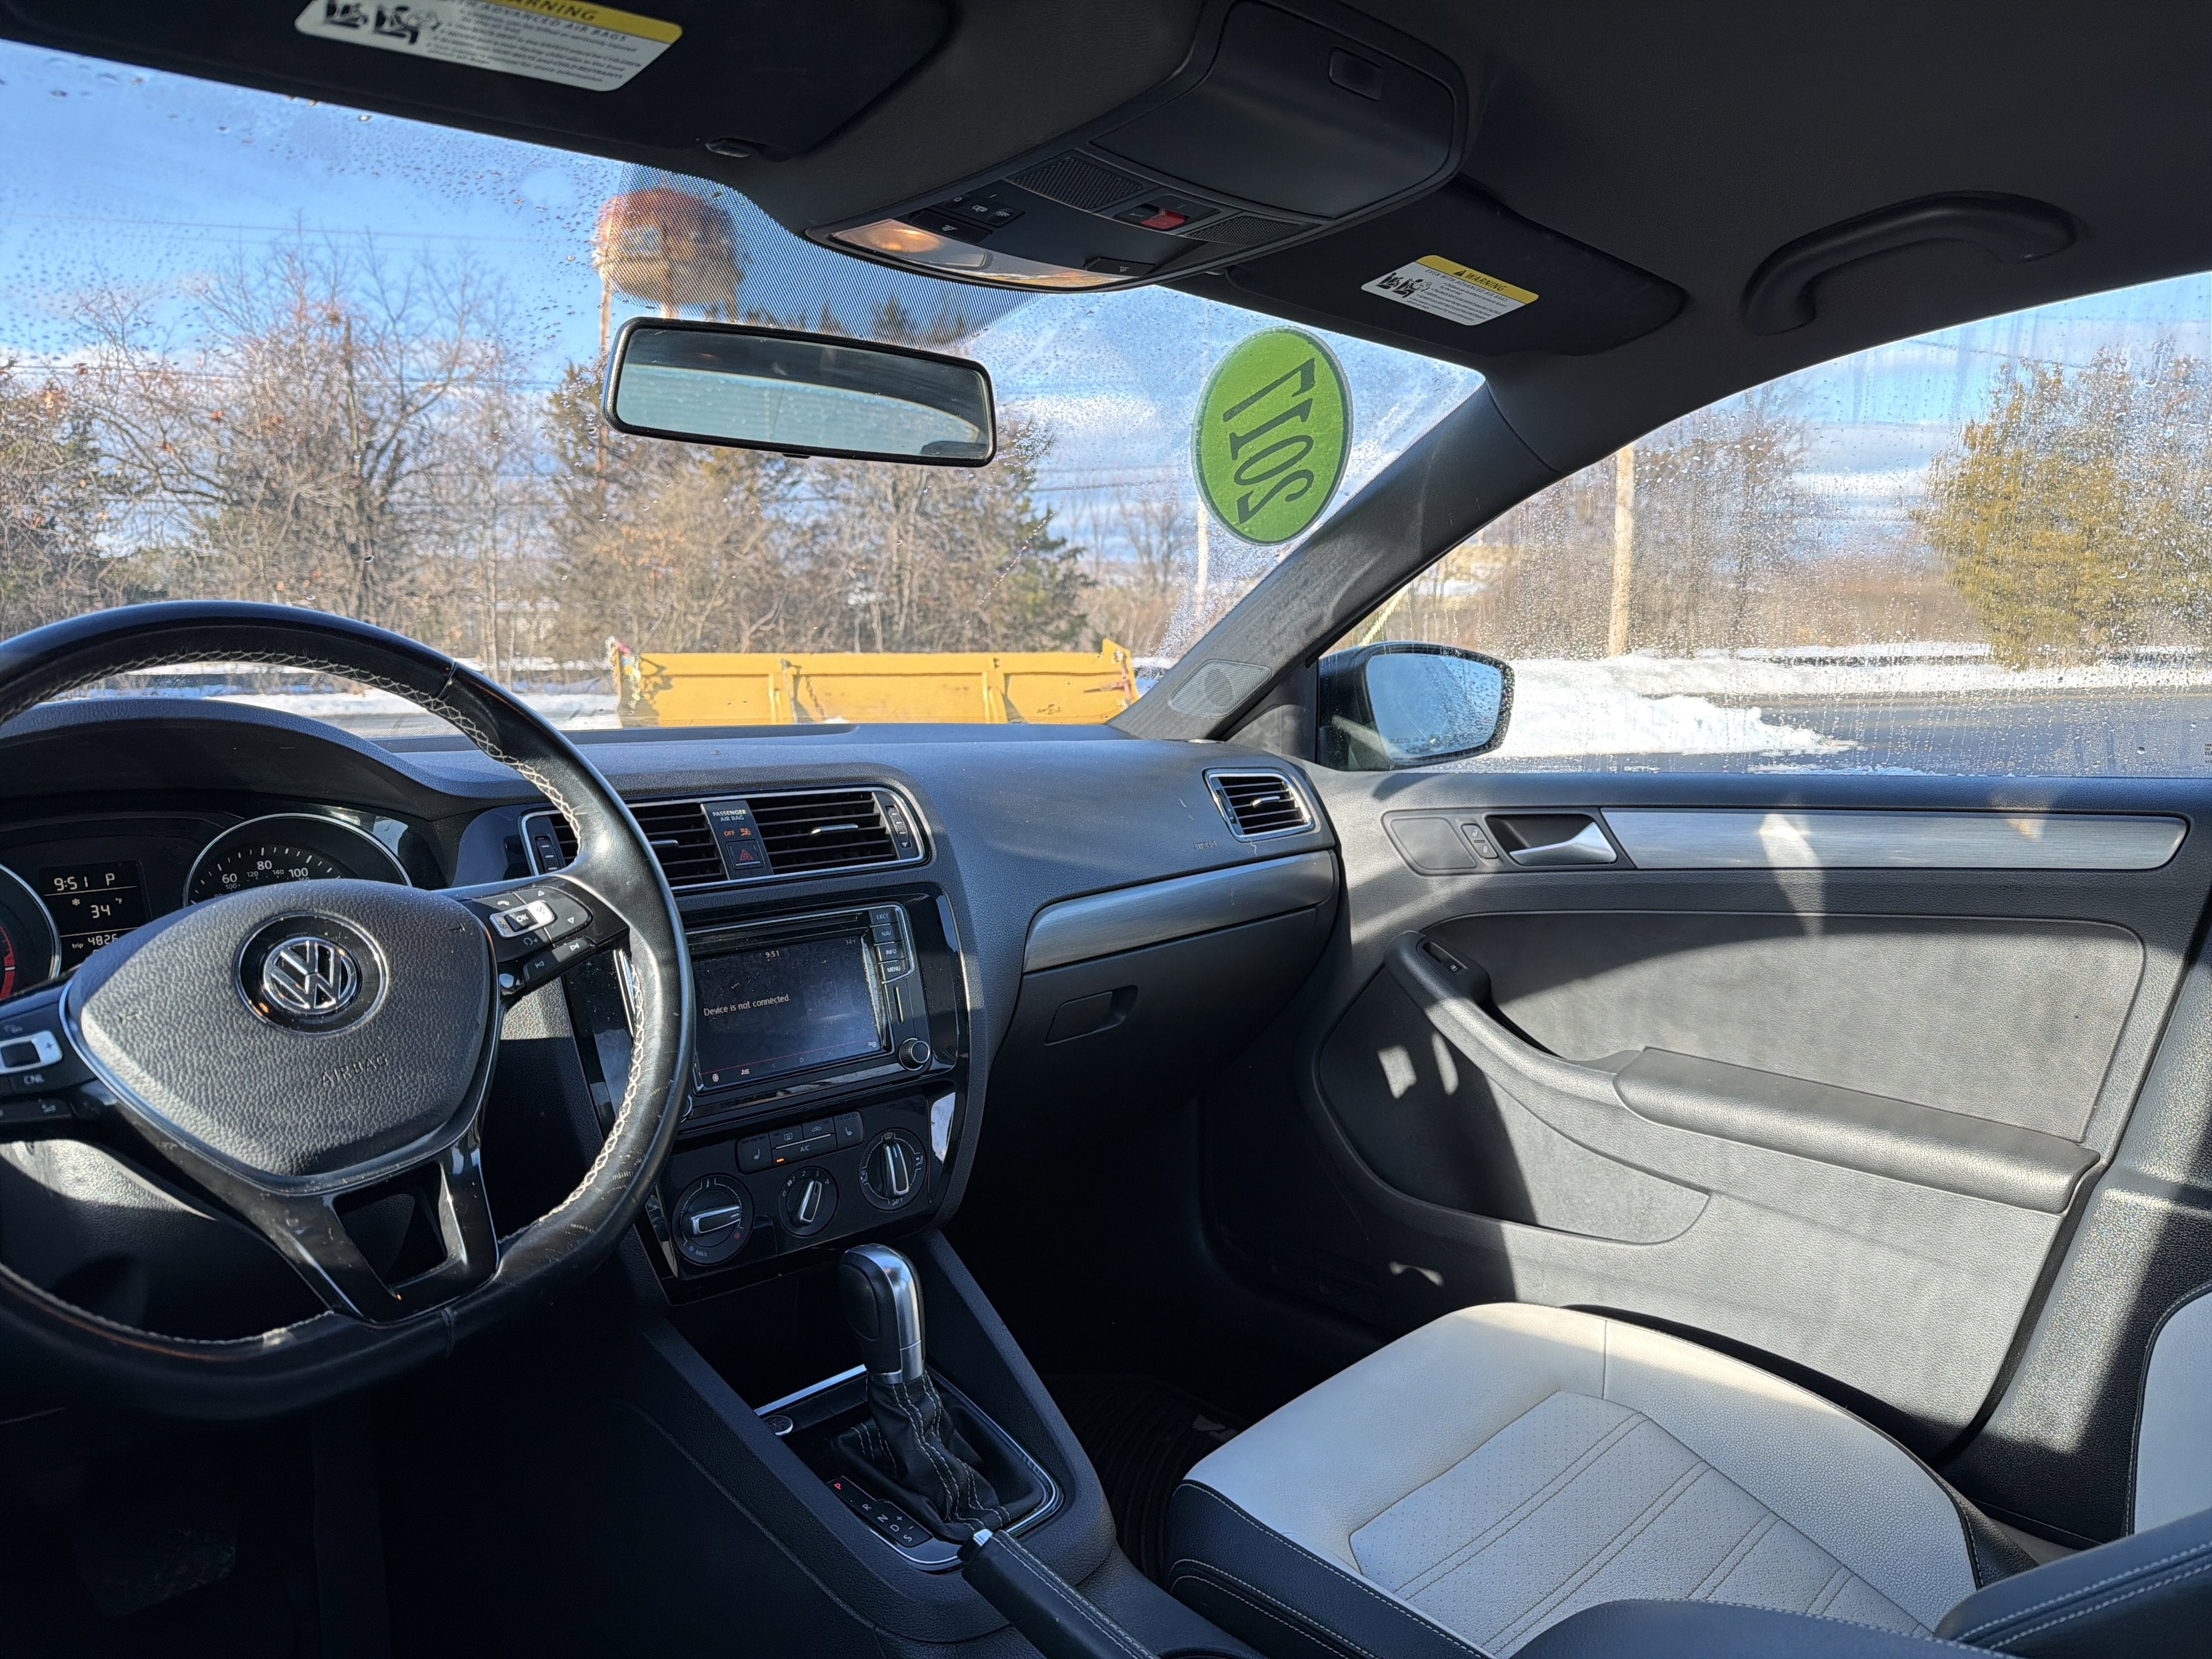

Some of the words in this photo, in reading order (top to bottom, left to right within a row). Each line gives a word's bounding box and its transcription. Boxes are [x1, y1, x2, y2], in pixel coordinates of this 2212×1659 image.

[1465, 273, 1507, 291] WARNING
[257, 860, 272, 871] 80
[288, 867, 308, 878] 100
[54, 876, 88, 891] 9:51
[105, 873, 115, 886] P
[222, 873, 238, 884] 60
[90, 905, 110, 918] 34
[516, 913, 529, 923] OK
[703, 1006, 728, 1016] Device
[738, 1001, 751, 1010] not
[321, 1053, 389, 1087] AIRBAG
[877, 1514, 888, 1523] N
[890, 1524, 899, 1532] D
[904, 1534, 912, 1542] S
